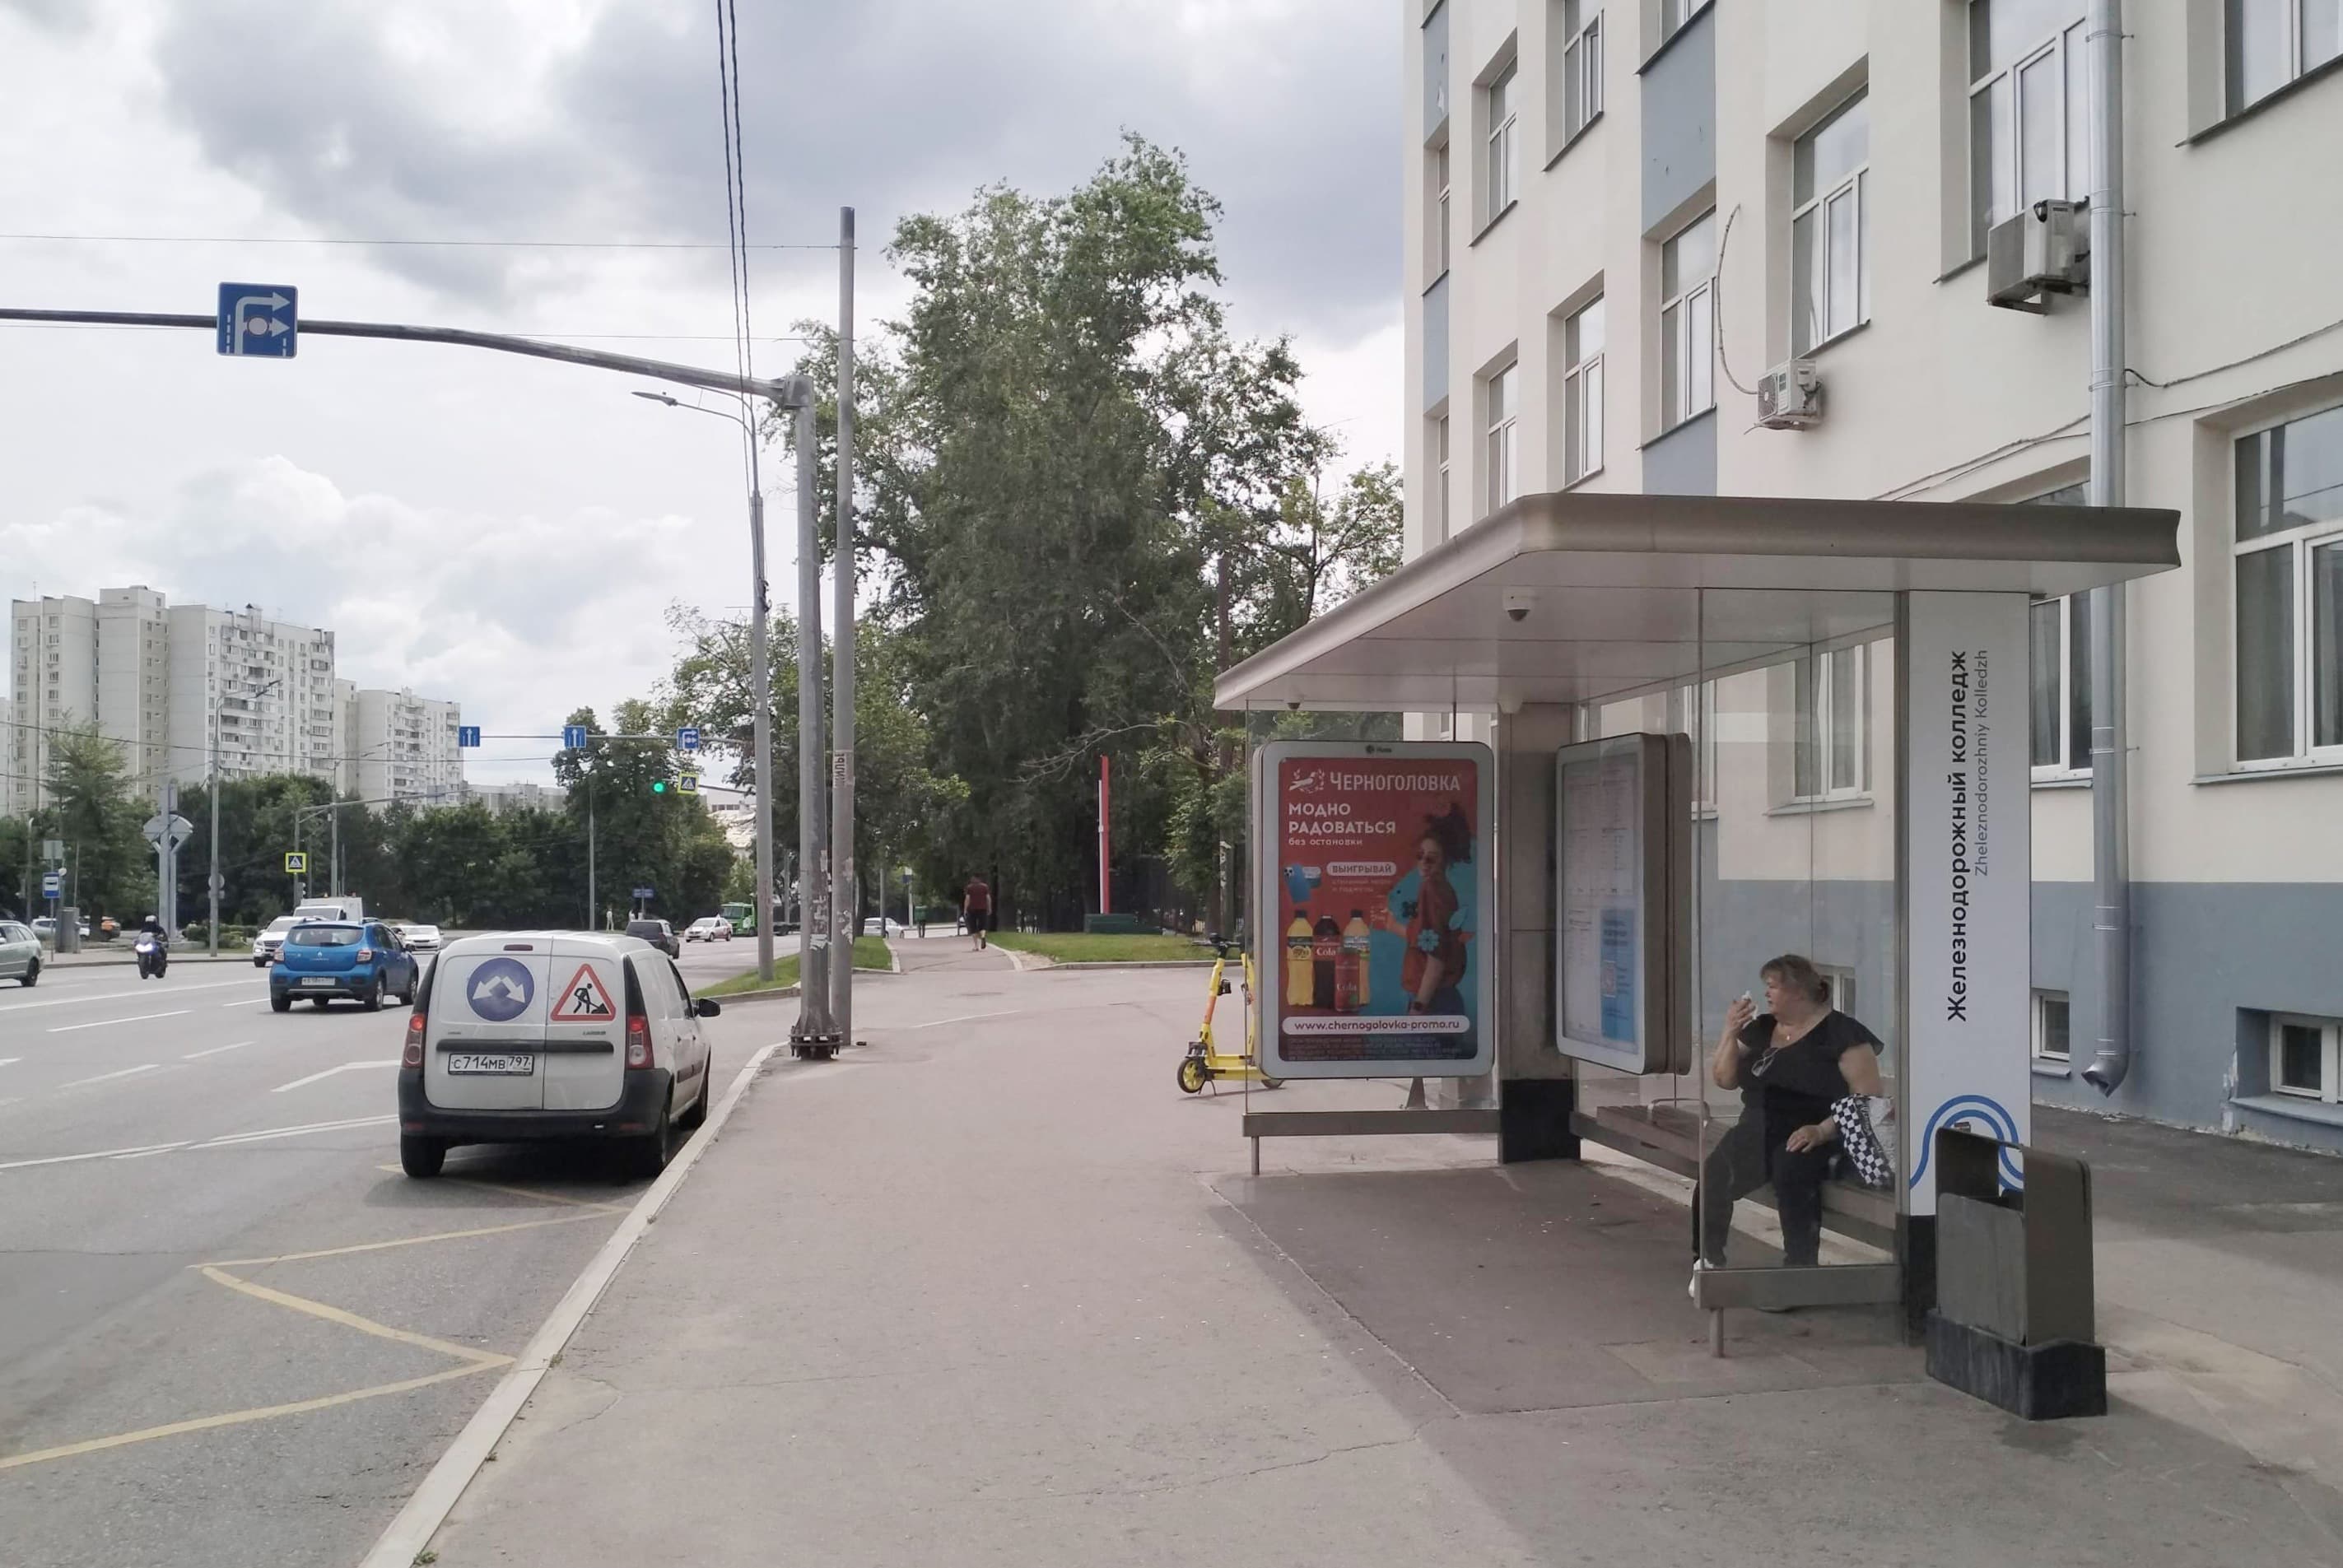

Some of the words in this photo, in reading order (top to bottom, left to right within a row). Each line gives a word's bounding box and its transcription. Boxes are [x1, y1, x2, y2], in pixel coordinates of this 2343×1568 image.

[1973, 650, 1988, 718] Kolledzh
[1952, 651, 1968, 763] колледж
[1330, 772, 1460, 791] ЧЕРНОГОЛОВКА
[1974, 723, 1990, 876] Zheleznodorozhniy
[1289, 803, 1351, 817] МОДНО
[1289, 821, 1395, 835] РАДОВАТЬСЯ
[1332, 863, 1392, 874] ВЫИГРЫВАЙ
[1947, 772, 1971, 1021] Железнодорожный
[1317, 947, 1336, 956] Cola
[1294, 1020, 1460, 1031] www.chernogolovka-promo.ru
[509, 1056, 529, 1067] 797
